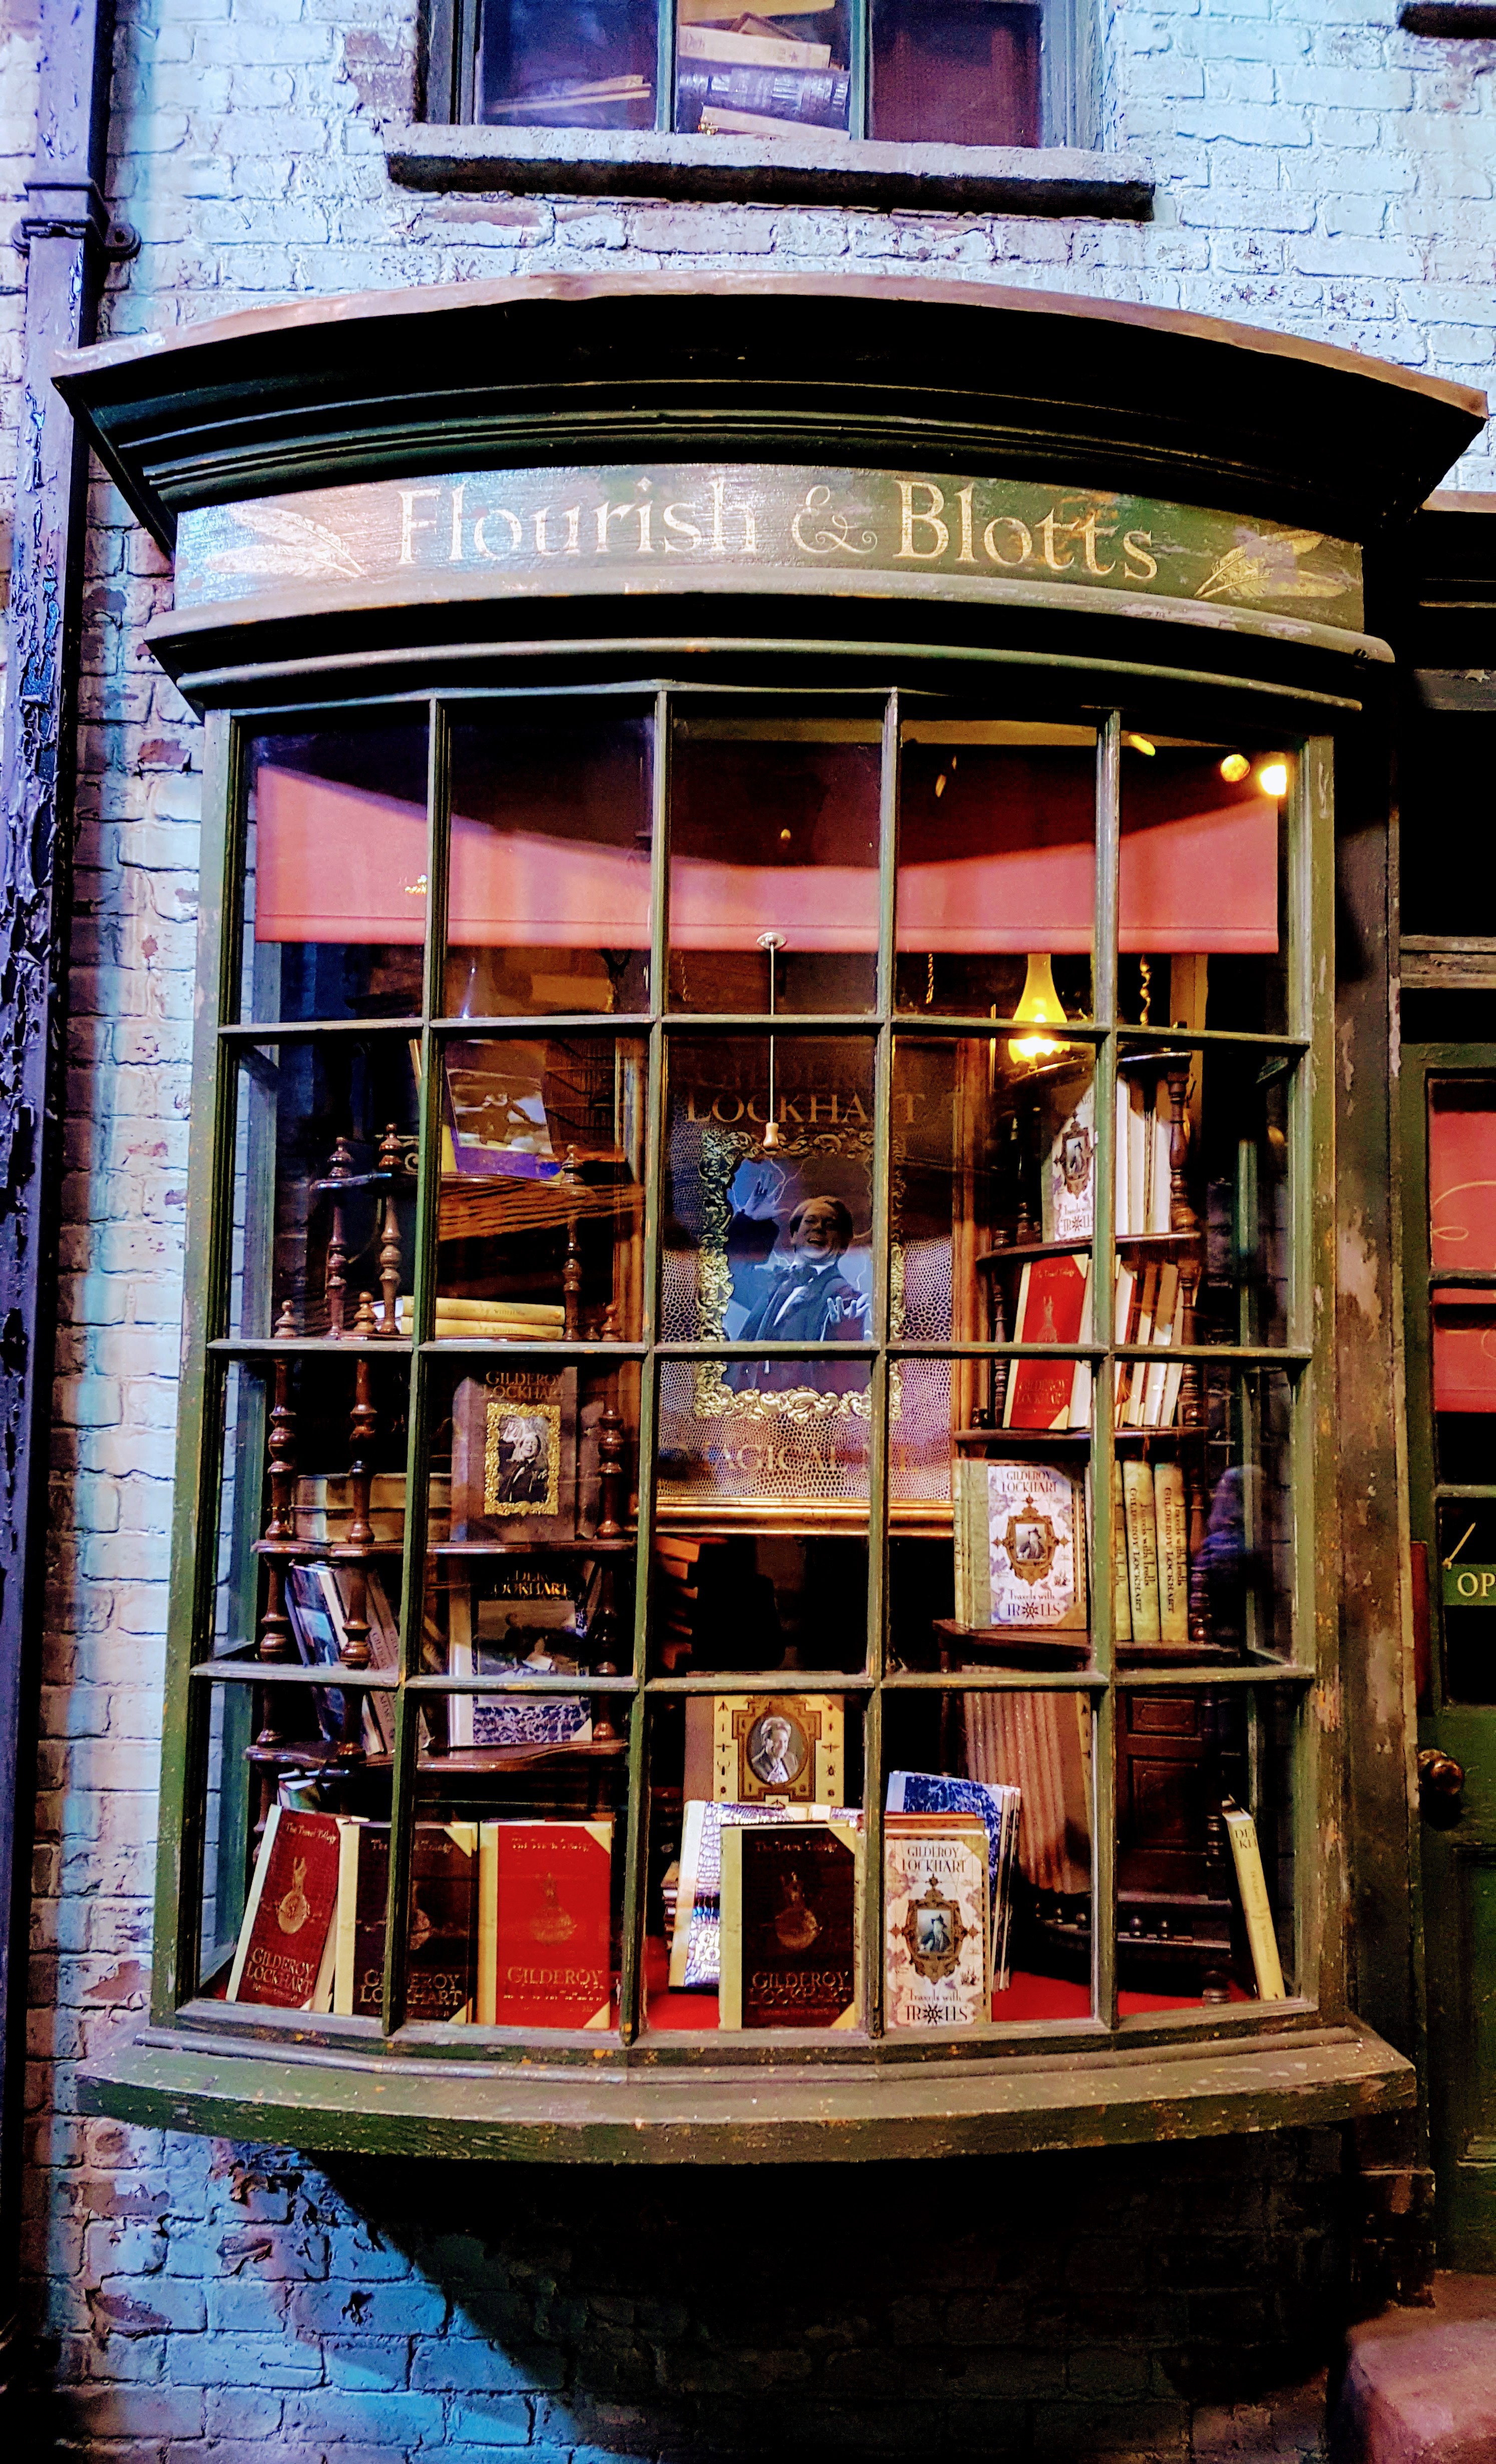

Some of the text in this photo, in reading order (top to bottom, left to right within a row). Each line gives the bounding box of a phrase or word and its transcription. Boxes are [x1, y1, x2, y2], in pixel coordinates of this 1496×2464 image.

[398, 476, 1158, 581] Flourish & Blotts
[685, 1092, 926, 1124] LOCKHAT
[702, 1443, 847, 1473] AGICAL
[1002, 1481, 1057, 1493] LOCKHART
[1006, 1471, 1050, 1481] GILDEROY
[907, 1846, 959, 1858] GILDEROY
[902, 1858, 966, 1873] LOCKHART
[252, 1947, 315, 1978] GILDEROY
[246, 1961, 313, 1996] LOCKHART
[364, 1968, 460, 1990] GEROY
[507, 1966, 603, 1985] GILDEROY
[752, 1970, 848, 1989] GILDEROY
[359, 1984, 463, 2006] LOHART
